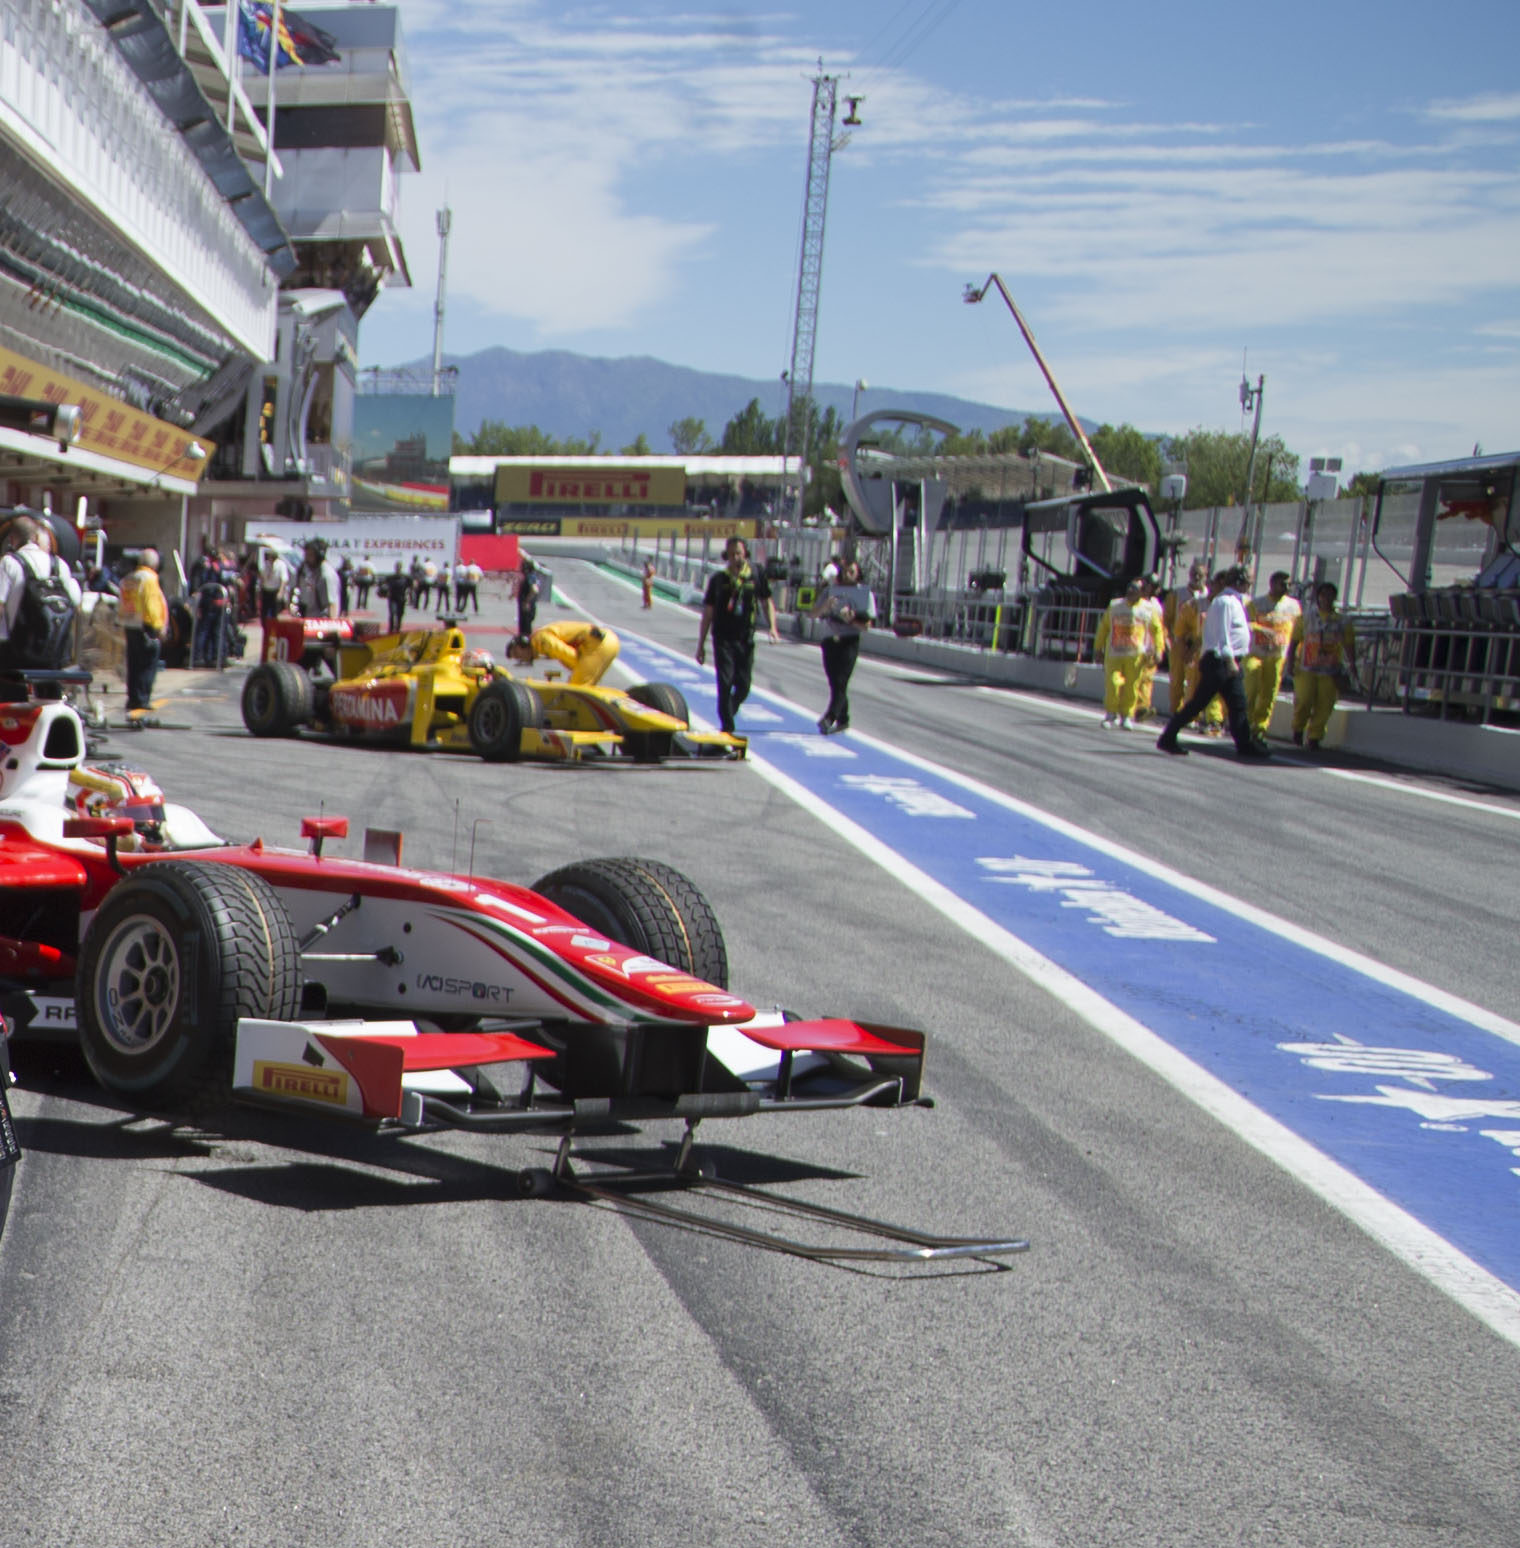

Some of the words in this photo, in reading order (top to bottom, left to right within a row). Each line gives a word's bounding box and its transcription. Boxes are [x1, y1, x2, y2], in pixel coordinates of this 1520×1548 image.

[530, 471, 649, 498] PIRELLI
[578, 523, 628, 535] PIRELLI
[291, 538, 351, 549] FOULA
[364, 538, 445, 550] EXPERIENCES
[263, 1067, 341, 1099] PIRELLI
